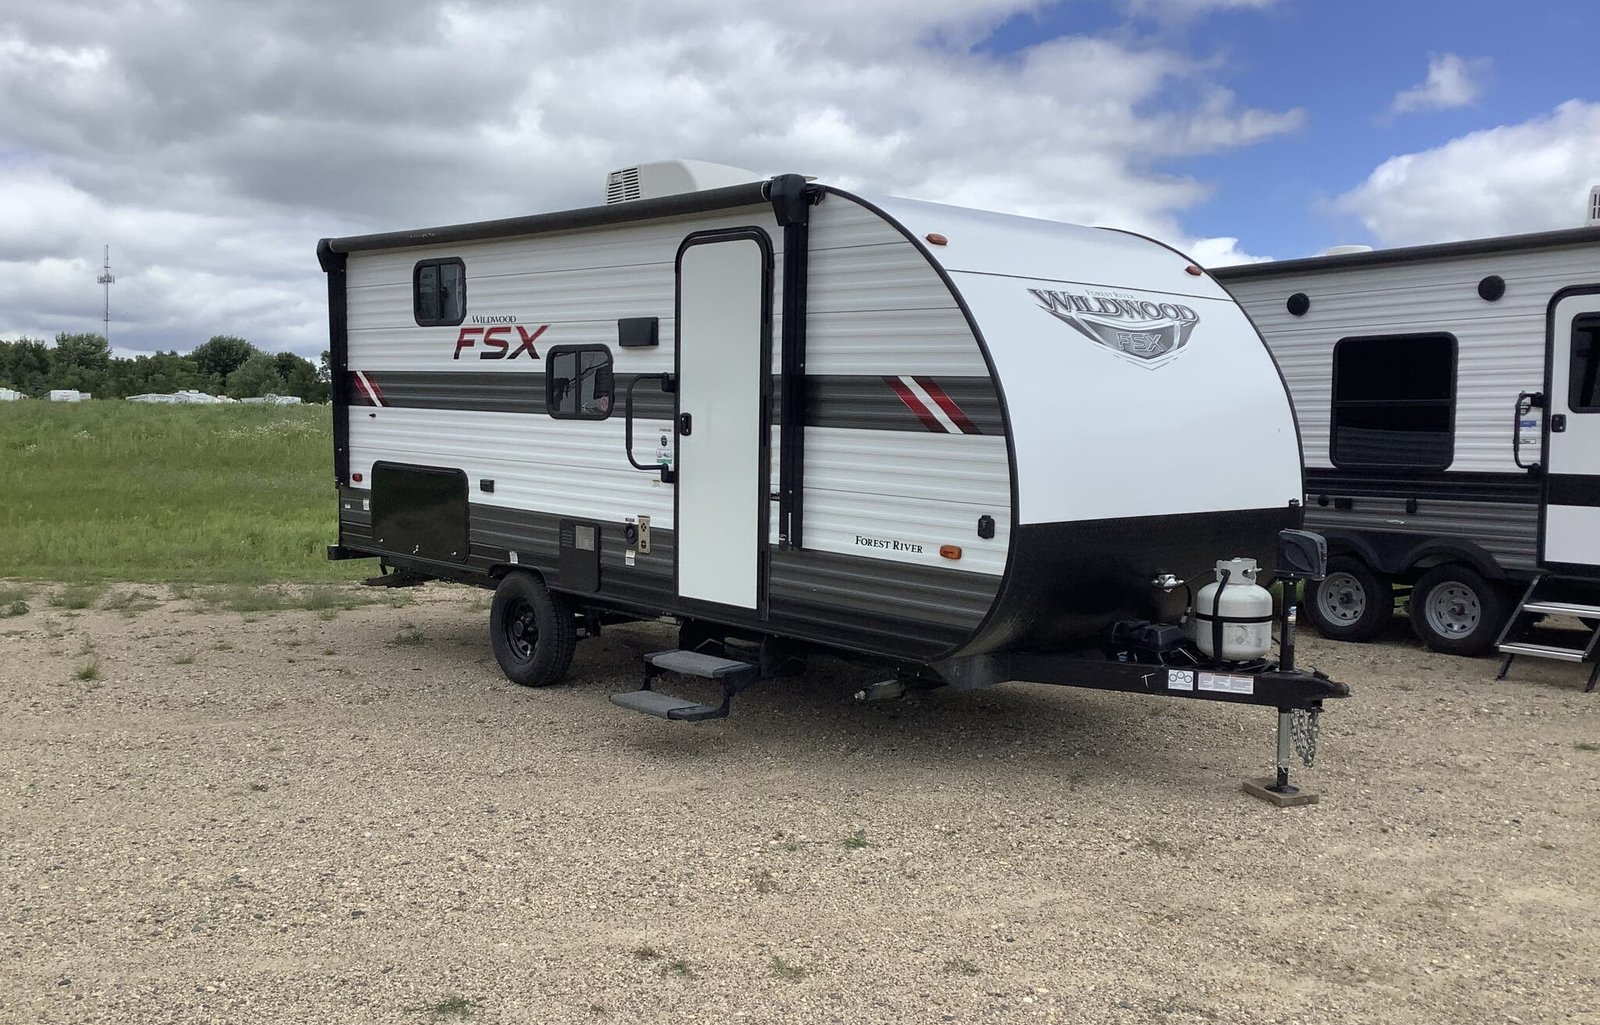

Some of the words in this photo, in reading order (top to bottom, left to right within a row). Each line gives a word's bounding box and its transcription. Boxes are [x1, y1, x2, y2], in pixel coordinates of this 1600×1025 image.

[1085, 289, 1114, 299] FOREST
[1114, 292, 1136, 300] RIVER
[1026, 288, 1200, 322] WILDWOOD
[472, 315, 517, 324] WILDWOOD
[453, 325, 549, 360] FSX
[1115, 331, 1164, 352] FSX
[855, 535, 891, 549] FOREST
[892, 540, 923, 554] RIVER
